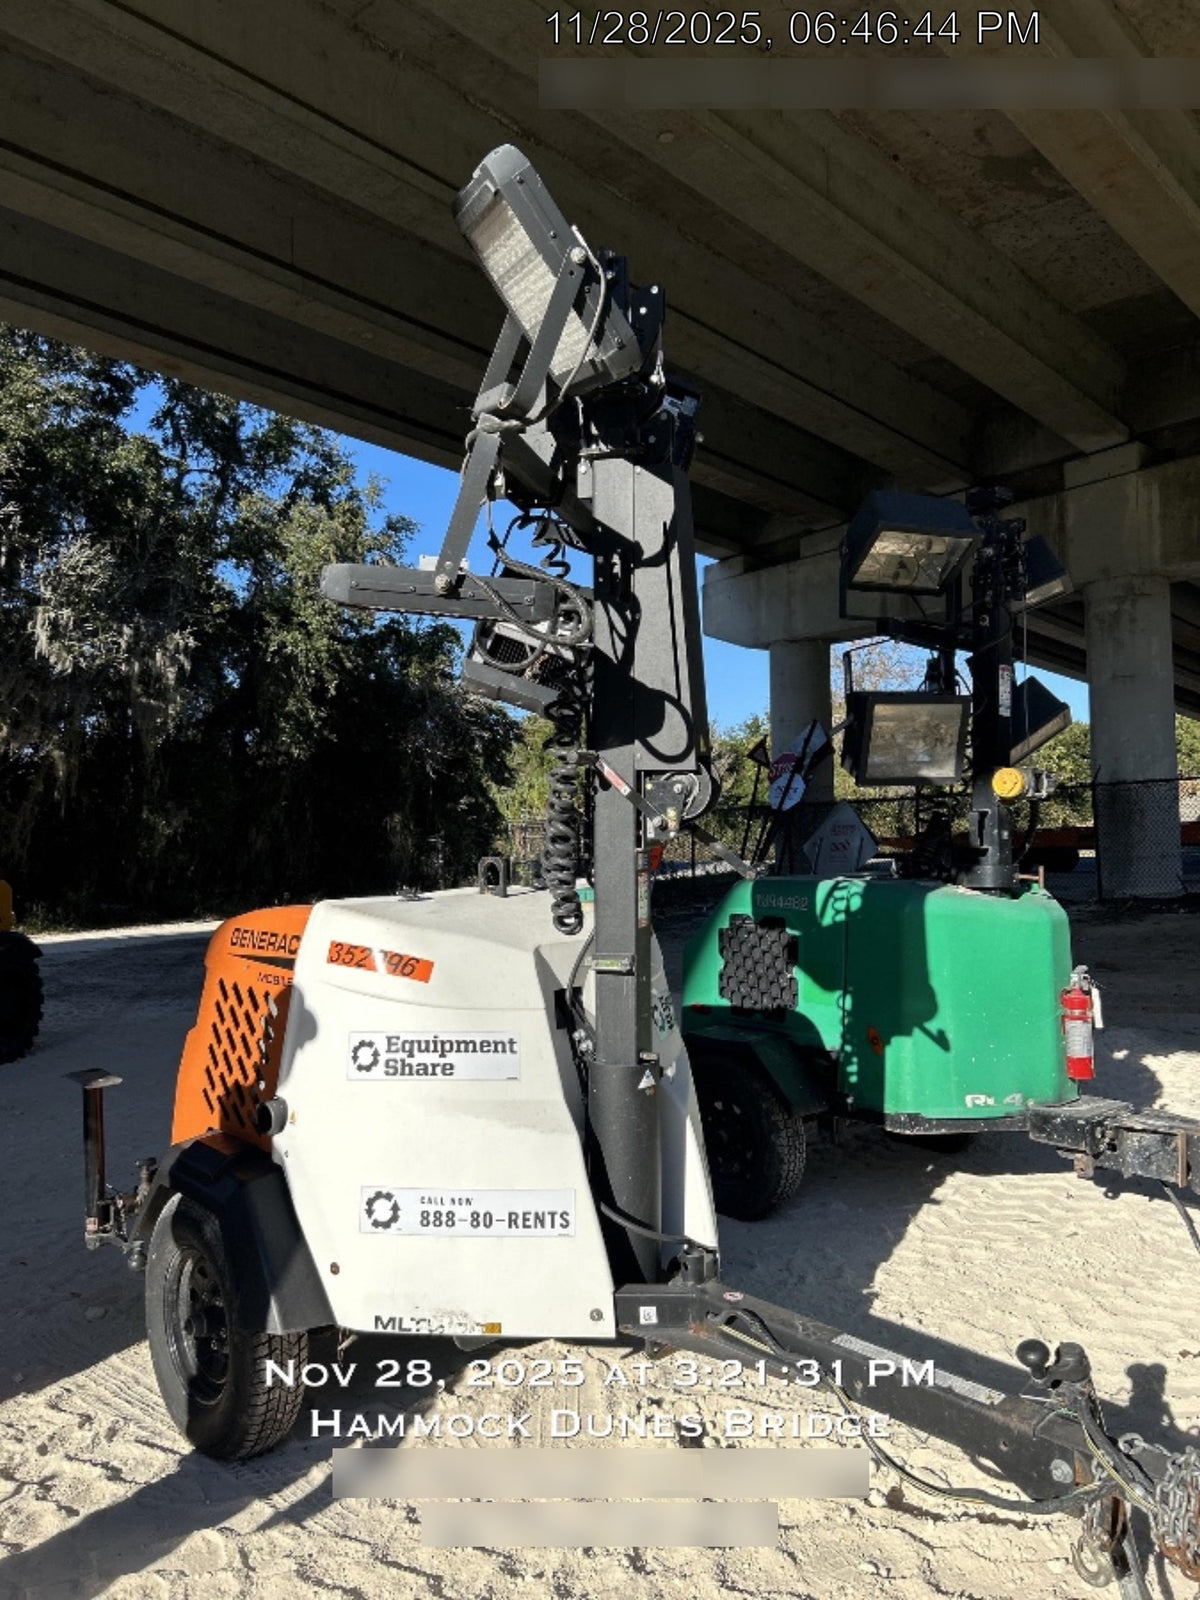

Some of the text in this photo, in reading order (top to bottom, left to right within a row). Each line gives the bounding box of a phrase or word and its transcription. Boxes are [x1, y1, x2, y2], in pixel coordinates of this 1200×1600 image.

[230, 927, 301, 955] GENERAC
[385, 1036, 518, 1060] Equipment
[384, 1058, 455, 1077] Share
[420, 1196, 445, 1206] CALL
[419, 1210, 571, 1230] 888-80-RENTS
